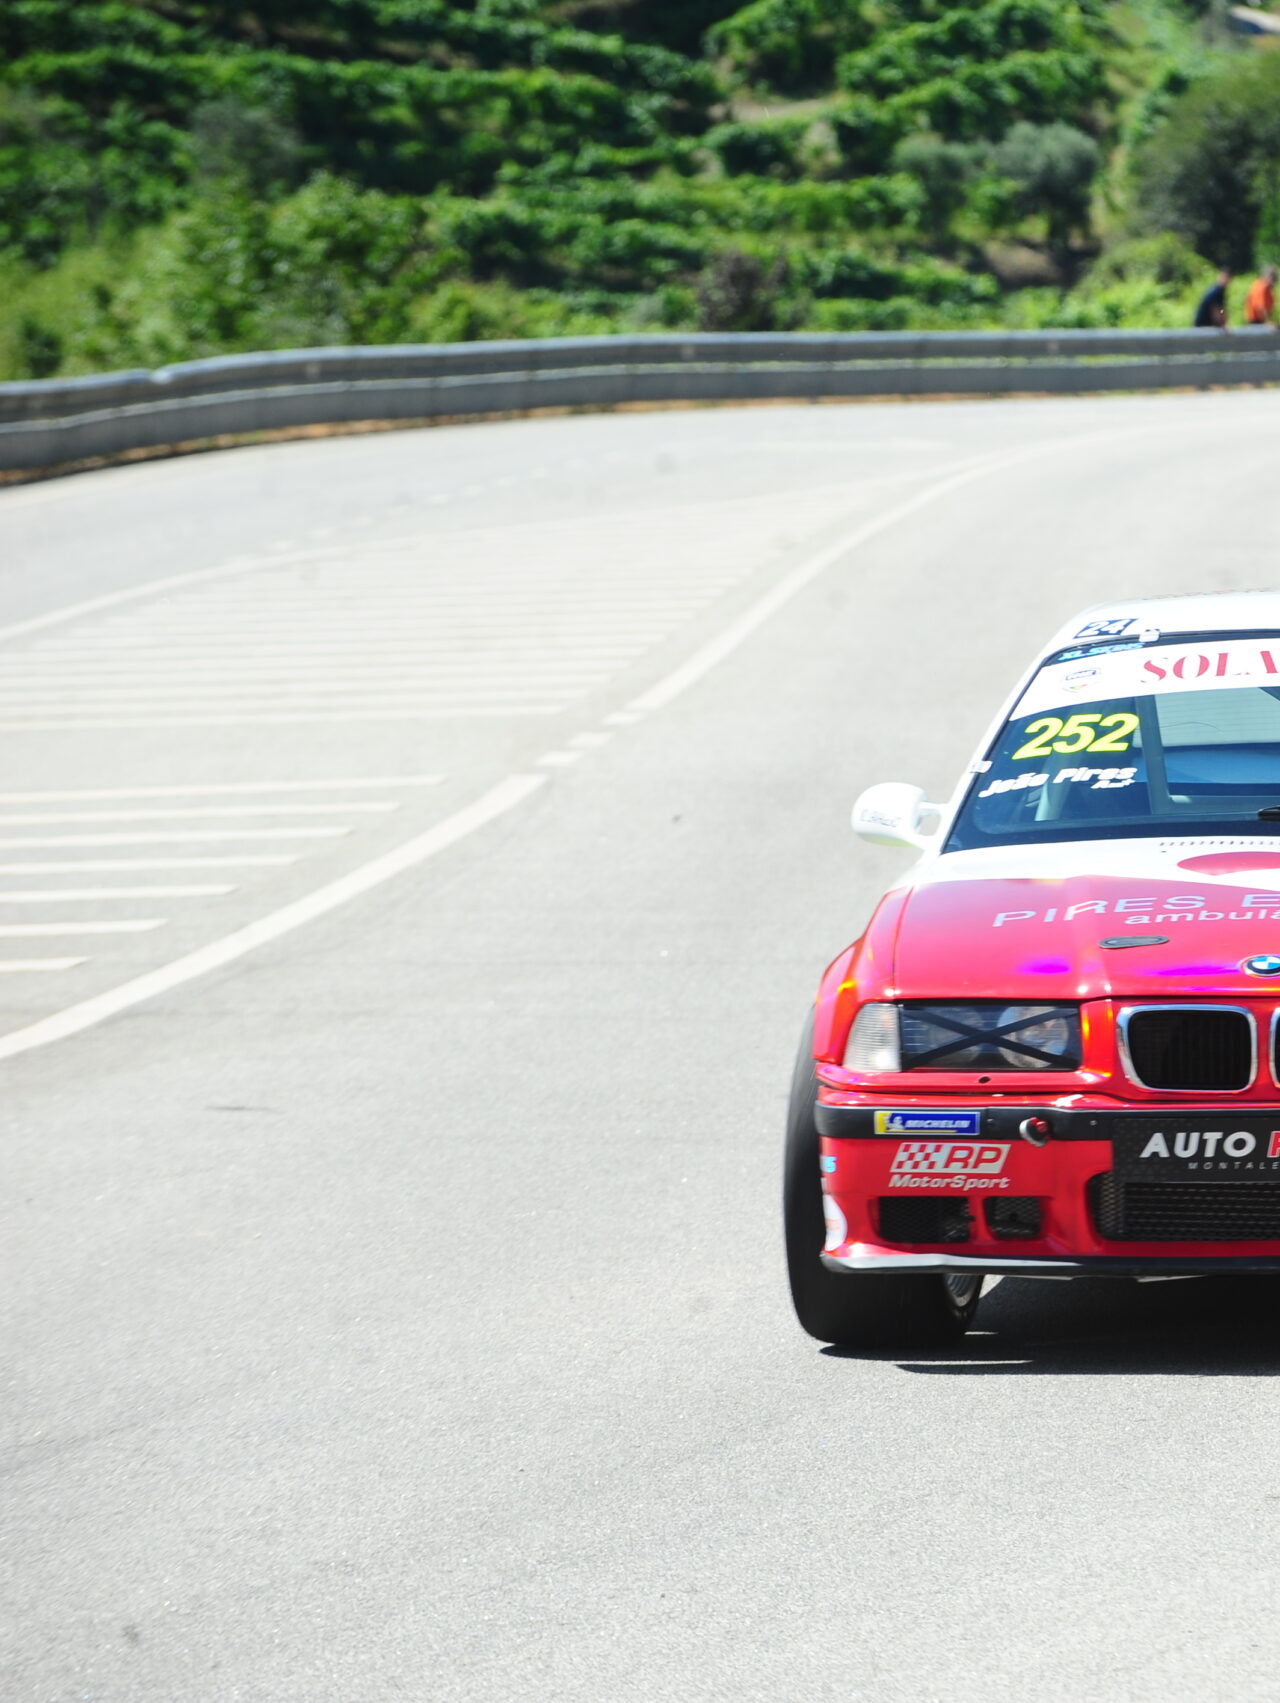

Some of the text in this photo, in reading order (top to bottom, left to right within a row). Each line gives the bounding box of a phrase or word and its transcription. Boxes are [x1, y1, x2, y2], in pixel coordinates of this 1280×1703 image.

[1011, 712, 1140, 760] 252
[1053, 766, 1138, 784] Pires
[992, 895, 1206, 927] PIRES
[905, 1119, 971, 1130] MICHELIN
[1139, 1131, 1257, 1158] AUTO
[943, 1145, 1004, 1170] RP
[888, 1174, 1011, 1191] MotorSport
